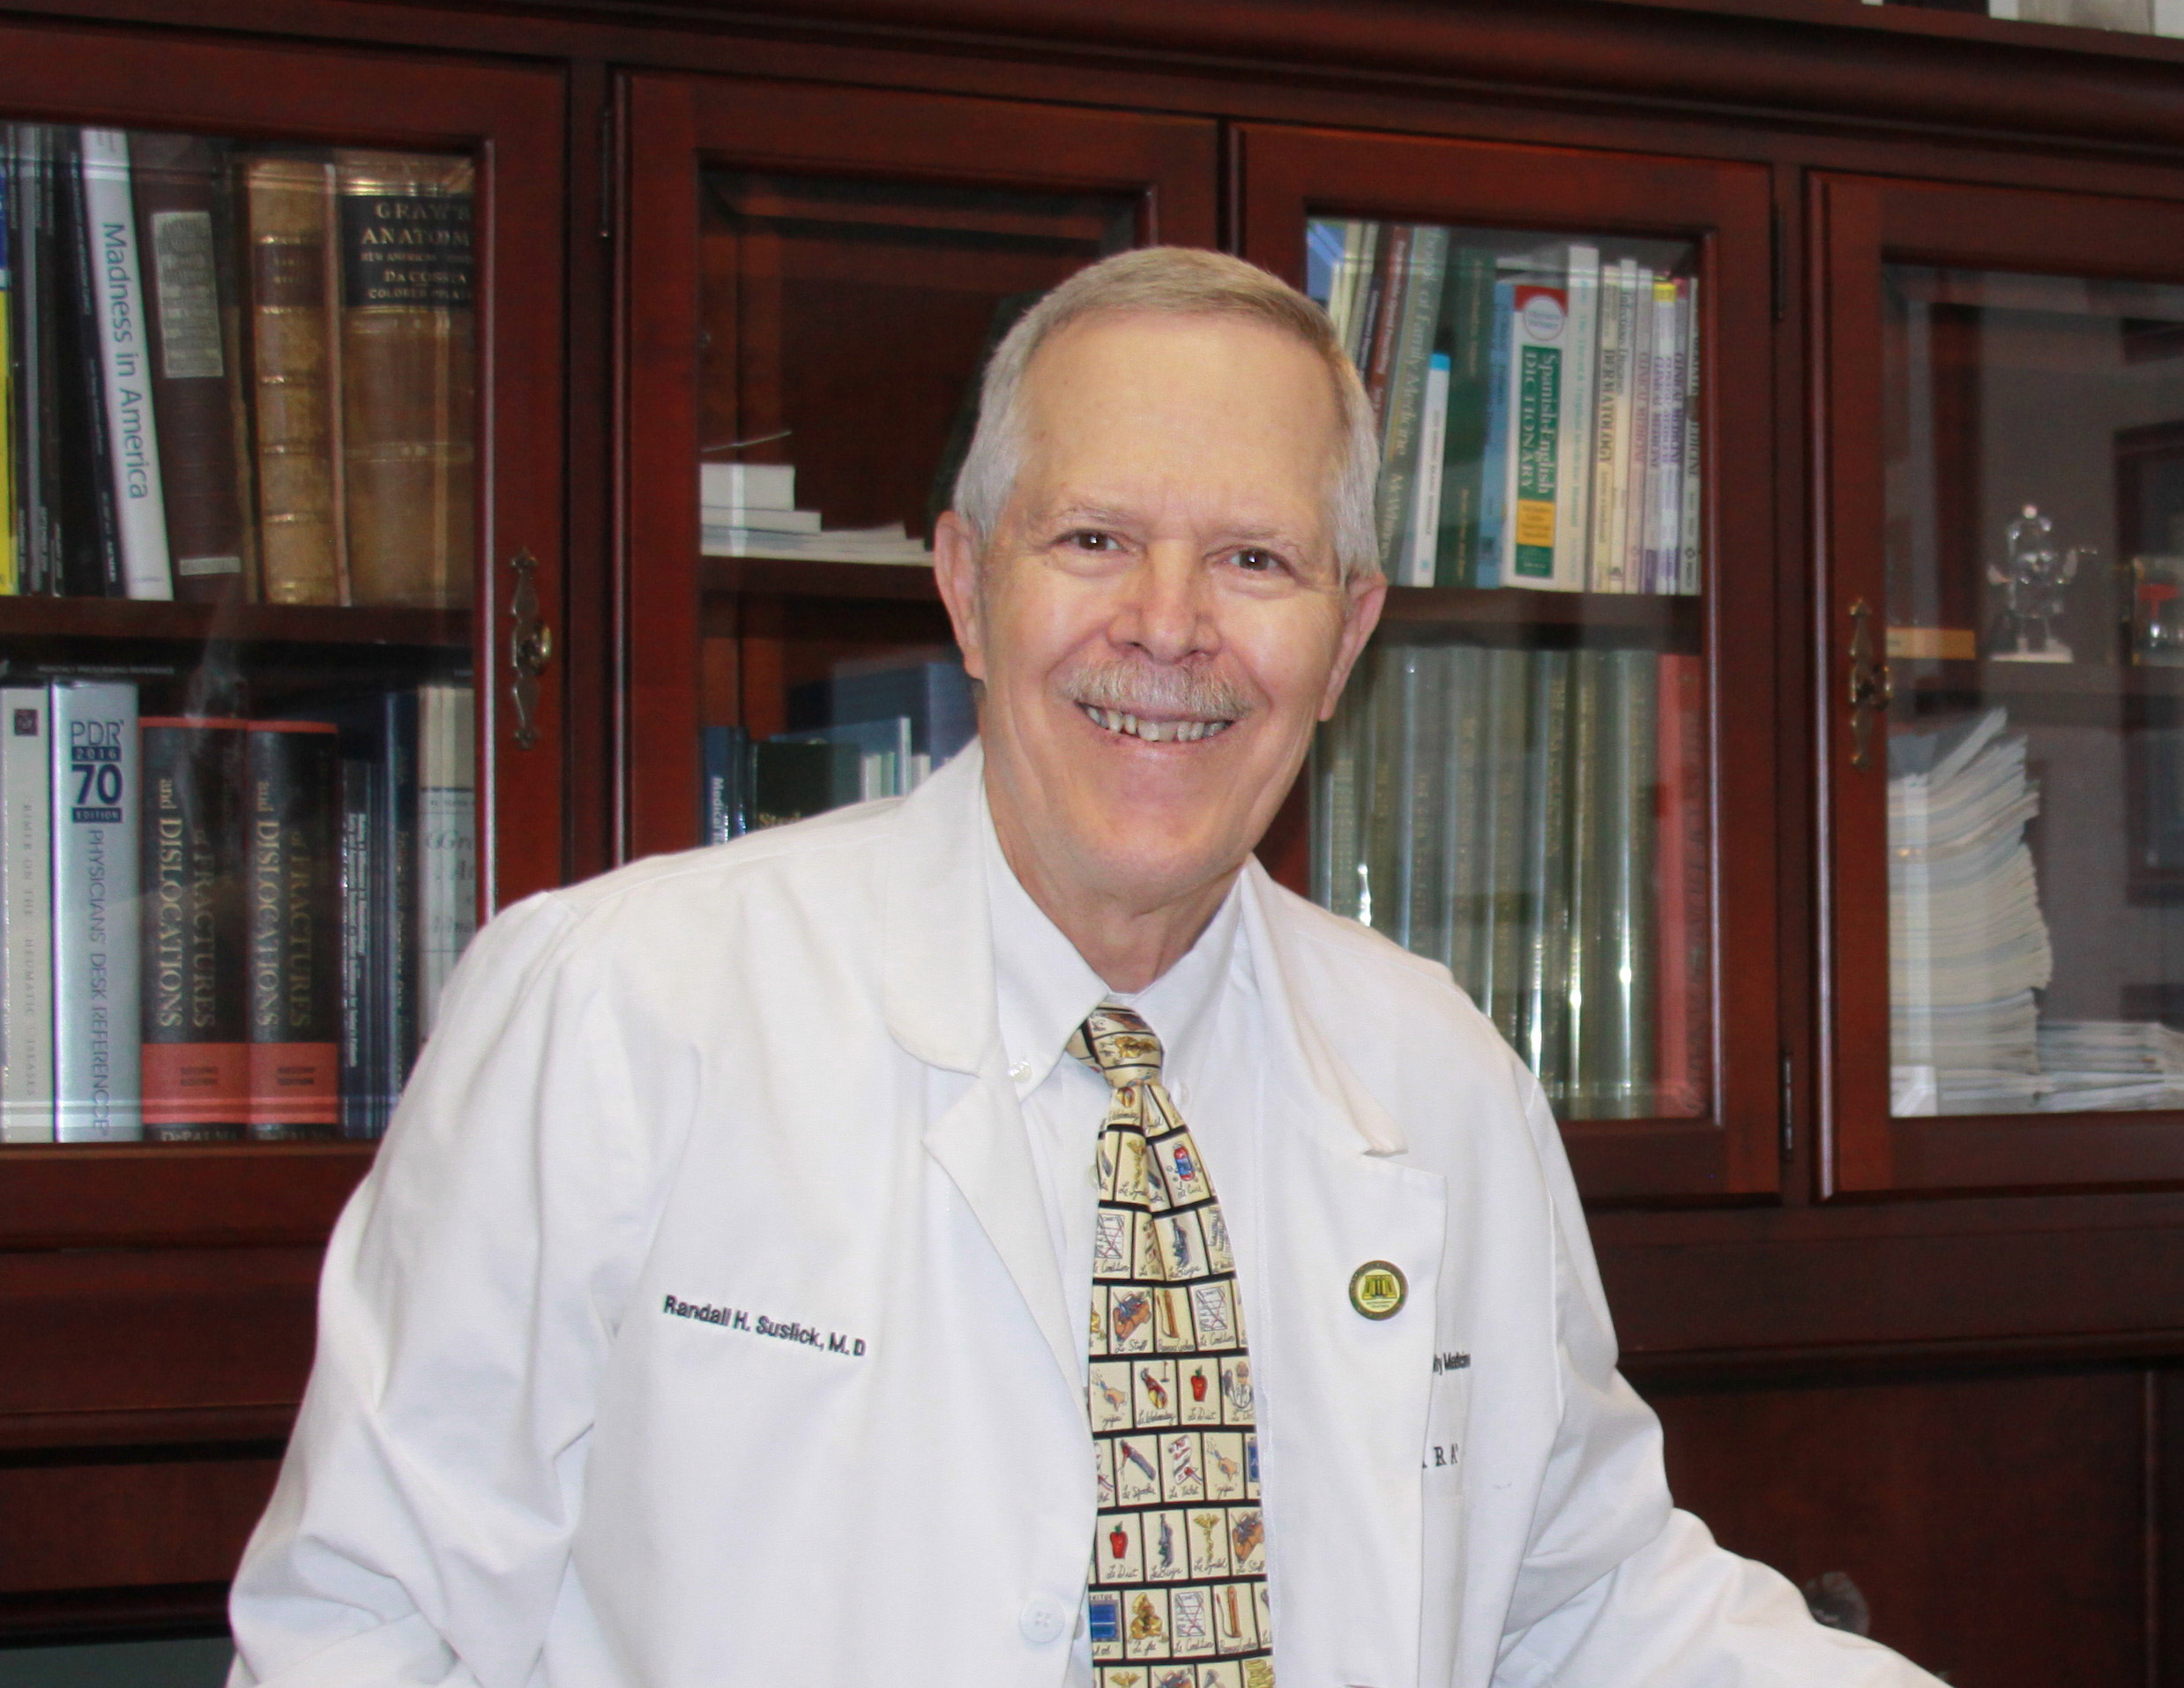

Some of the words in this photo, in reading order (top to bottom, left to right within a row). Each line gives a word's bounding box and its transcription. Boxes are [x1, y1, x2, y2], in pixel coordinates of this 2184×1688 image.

[102, 221, 133, 343] Madness
[116, 352, 136, 377] in
[1408, 314, 1432, 365] Family
[1395, 374, 1420, 457] Medicine
[1521, 353, 1538, 491] DICTIONARY
[1599, 349, 1615, 461] DERMATOLOGY
[119, 387, 148, 499] America
[71, 763, 123, 805] 70
[76, 748, 118, 761] 2016
[75, 809, 120, 820] EDITION
[160, 778, 178, 810] and
[257, 781, 274, 812] and
[159, 818, 183, 1027] DISLOCATIONS
[192, 852, 217, 1027] FRACTURES
[257, 820, 280, 1027] DISLOCATIONS
[289, 854, 312, 1027] FRACTURES
[91, 952, 108, 997] DESK
[664, 1294, 732, 1327] Randall
[733, 1309, 751, 1333] H.
[756, 1314, 825, 1352] Suslick,
[828, 1331, 851, 1356] M.
[853, 1337, 867, 1357] D
